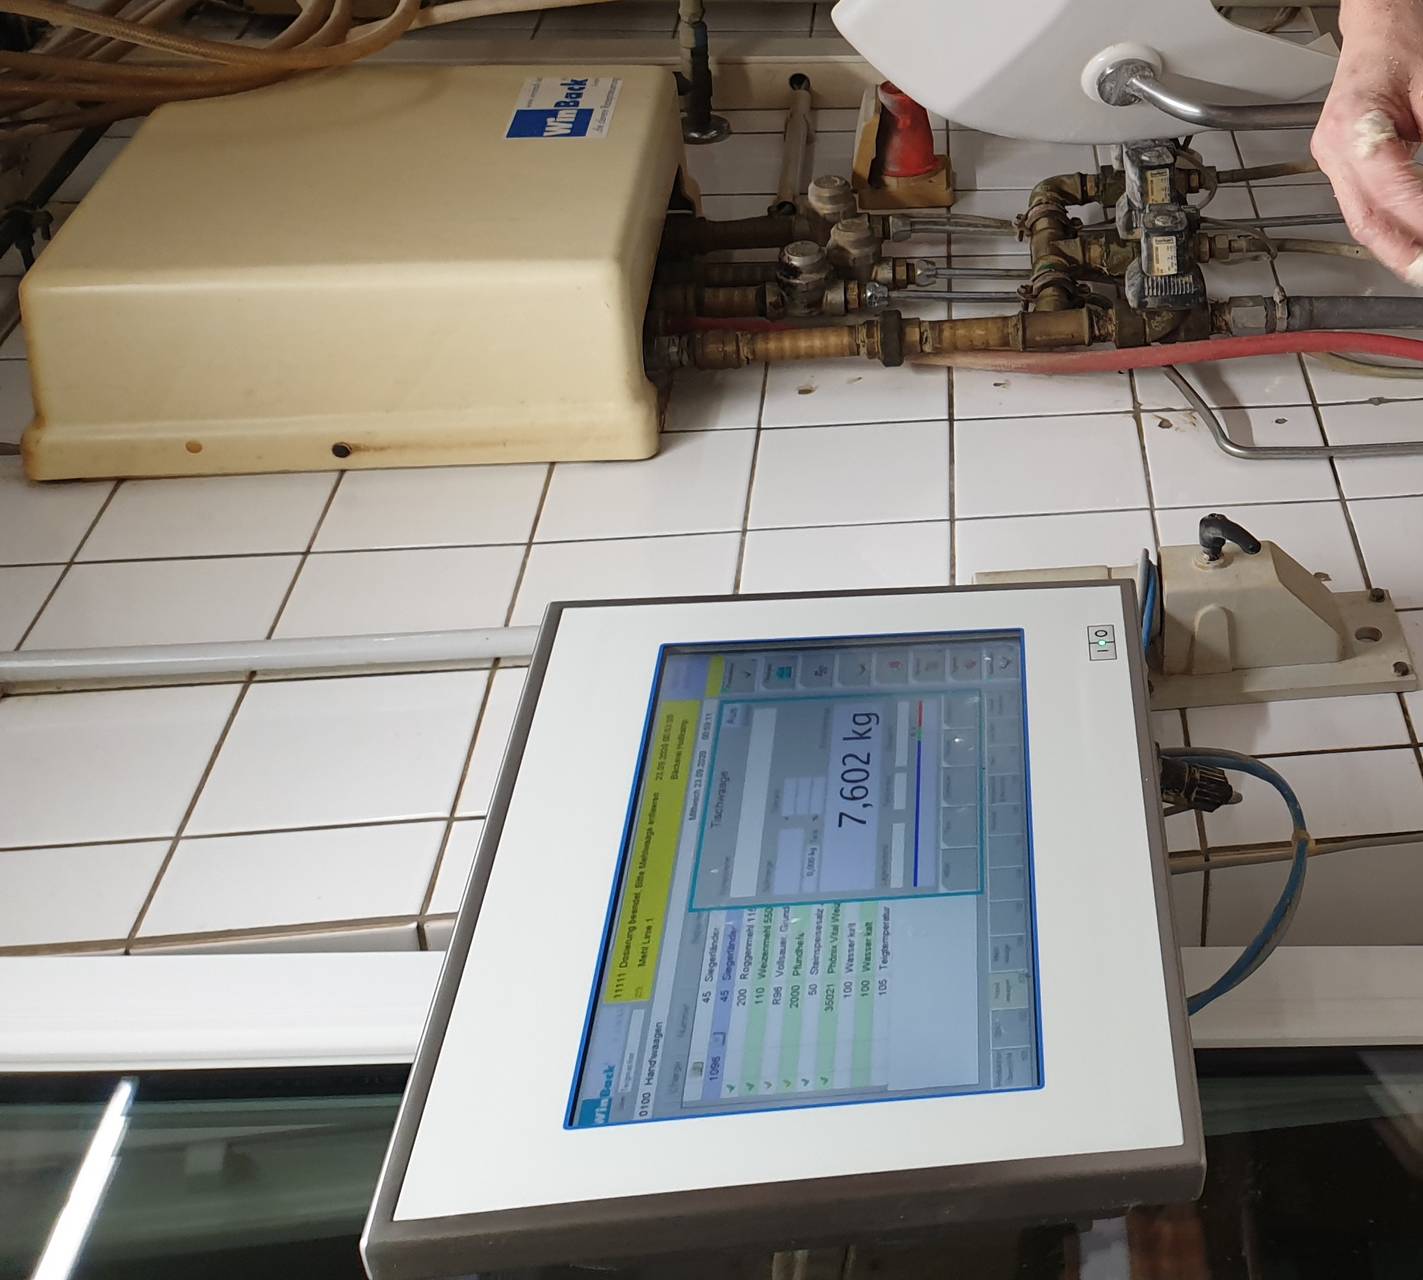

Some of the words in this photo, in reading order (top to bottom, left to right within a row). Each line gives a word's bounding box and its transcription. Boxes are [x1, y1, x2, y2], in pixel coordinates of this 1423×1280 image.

[543, 78, 588, 137] WinBack
[841, 711, 881, 741] kg
[710, 770, 730, 829] Tischwaage
[837, 752, 875, 829] 7,602
[810, 908, 825, 975] Steinspeisesalz
[828, 923, 840, 942] Vital
[864, 921, 873, 936] kalt
[879, 906, 891, 970] Teigtemperatur
[618, 925, 638, 969] Dosierung
[739, 924, 756, 980] Roggenmehl
[758, 925, 773, 979] Weizenmehl
[845, 939, 857, 973] Wasser
[862, 938, 872, 972] Wasser
[613, 972, 627, 999] 11111
[701, 990, 712, 1003] 45
[736, 988, 748, 1007] 200
[755, 987, 766, 1005] 110
[772, 986, 783, 1005] R96
[789, 985, 801, 1008] 2000
[808, 984, 819, 996] 50
[824, 984, 835, 1012] 35021
[843, 981, 854, 998] 100
[861, 980, 871, 997] 100
[879, 979, 888, 996] 105
[708, 1056, 721, 1081] 1096
[720, 990, 730, 1002] 45
[593, 1064, 616, 1124] WinBack
[638, 1091, 652, 1117] 0100
